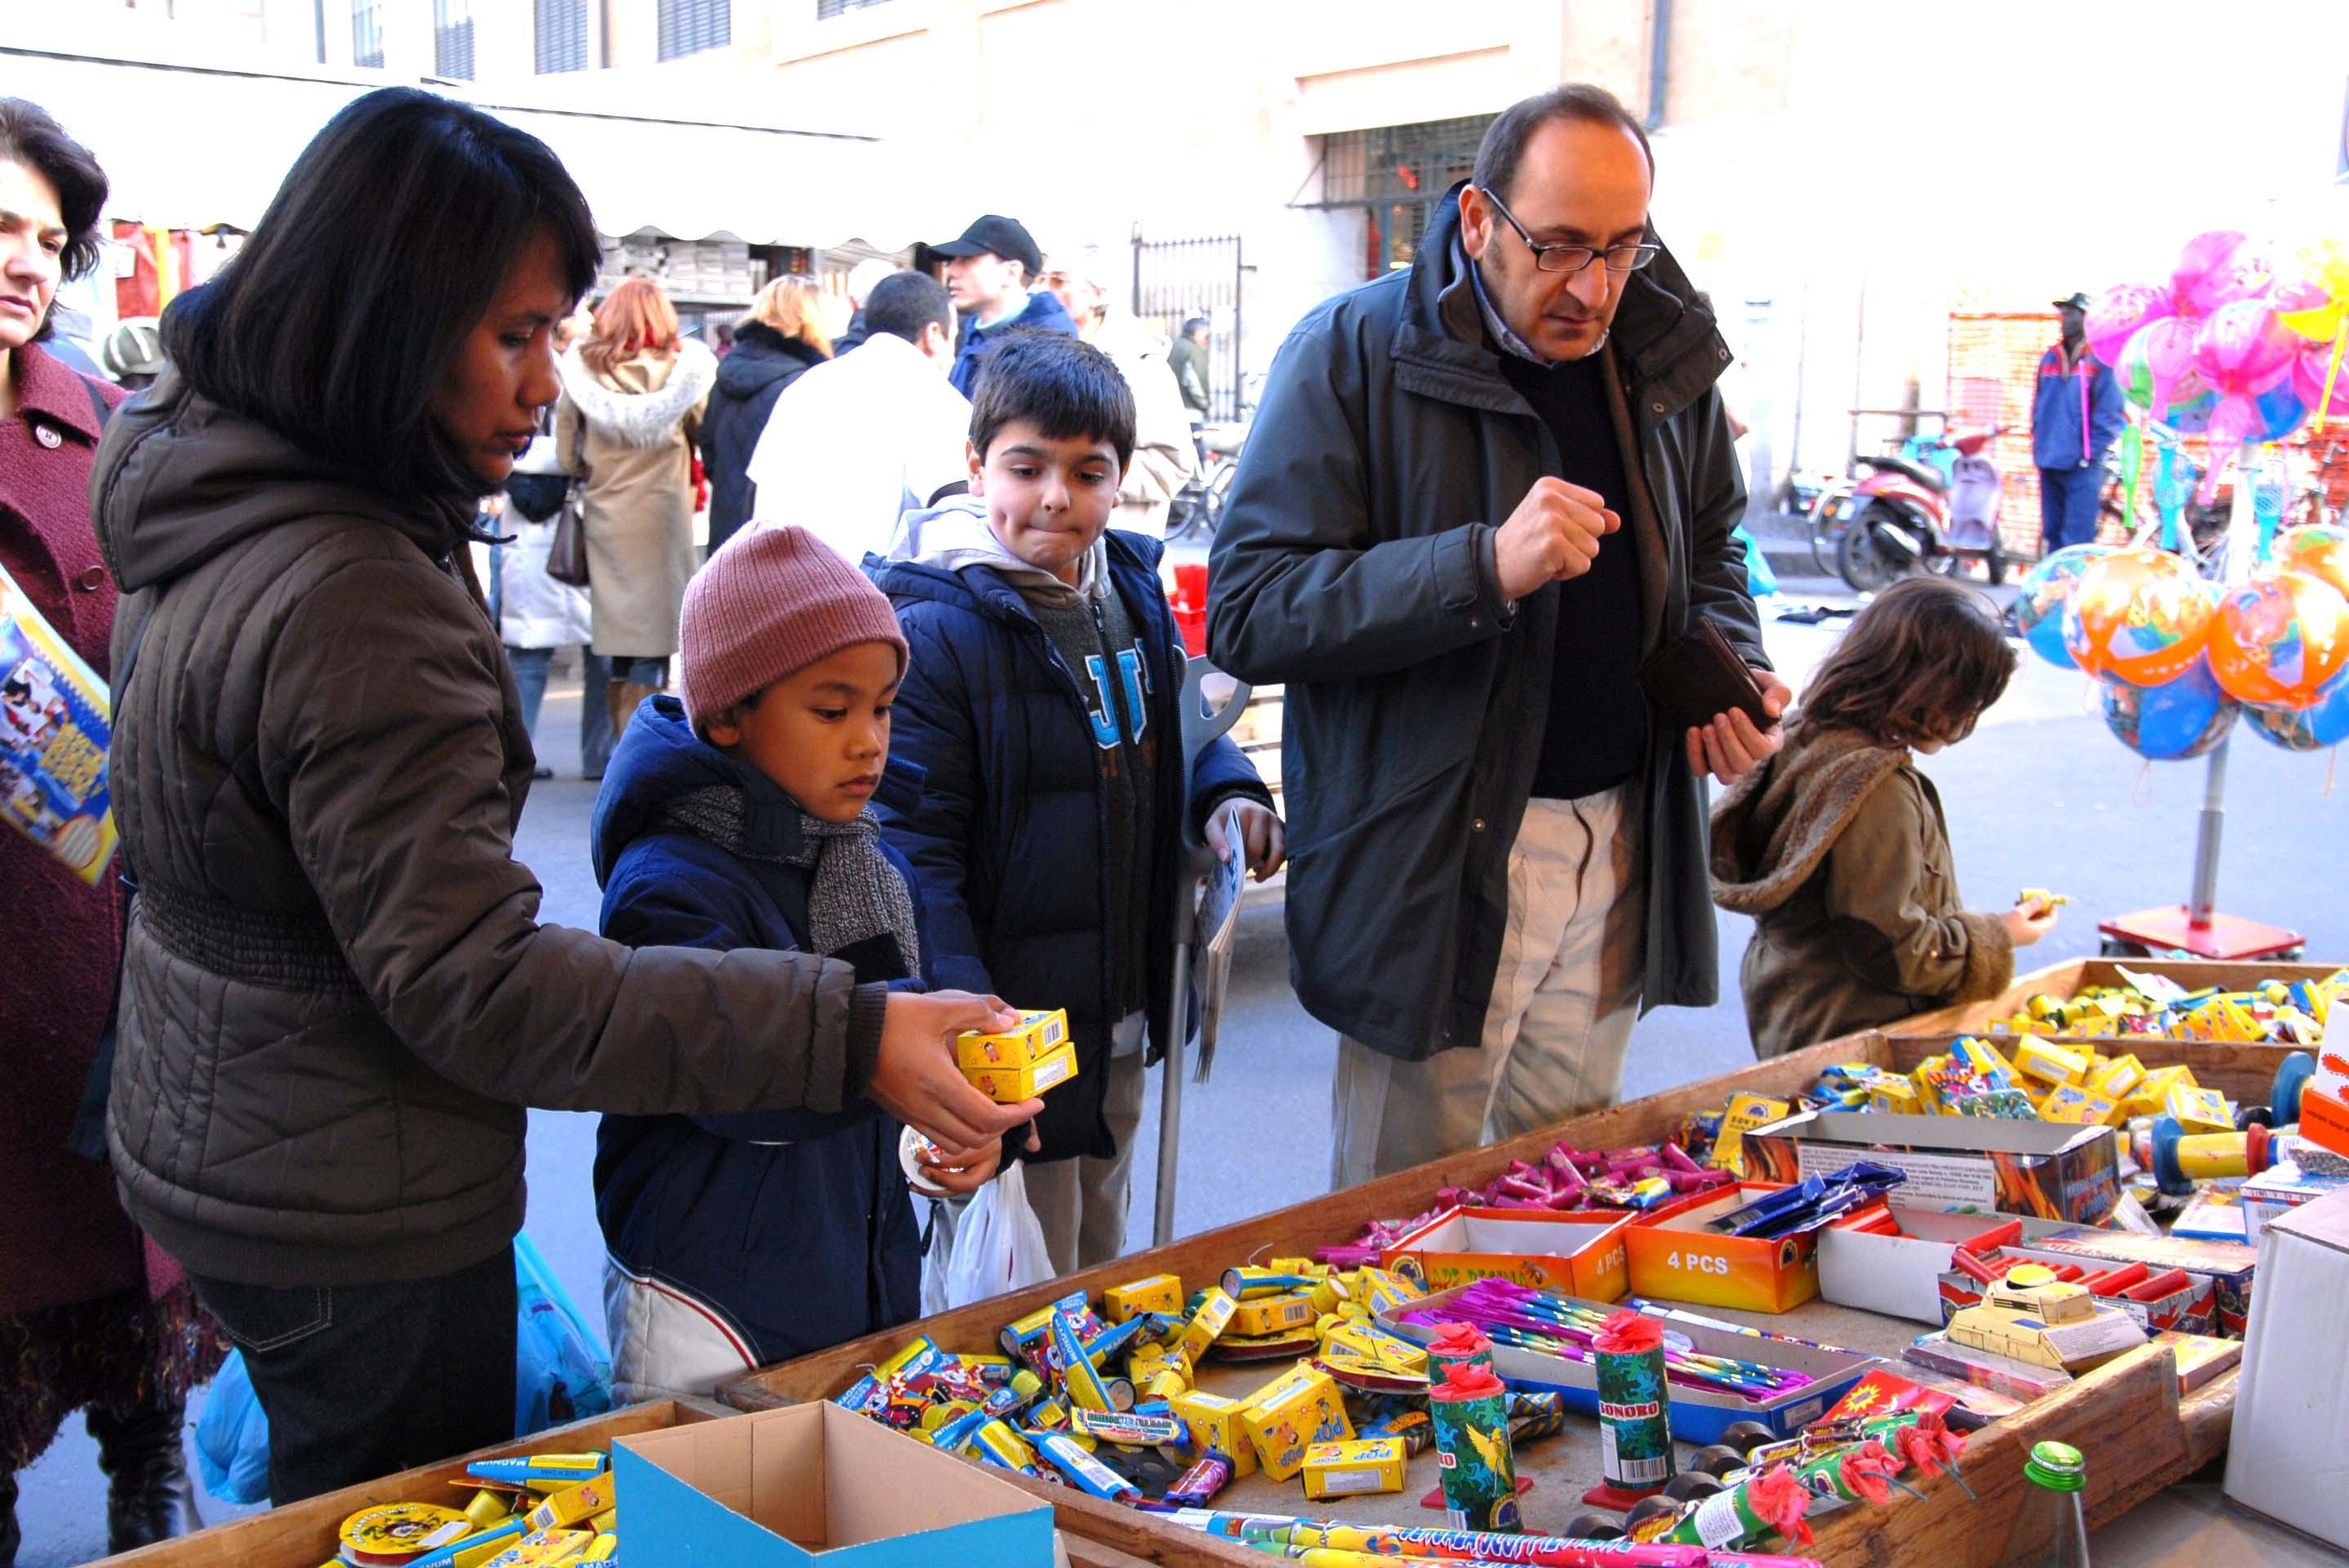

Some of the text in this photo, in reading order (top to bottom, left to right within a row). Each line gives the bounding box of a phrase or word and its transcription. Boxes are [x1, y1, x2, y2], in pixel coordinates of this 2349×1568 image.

[1667, 1251, 1728, 1275] 4 PCS
[1280, 1444, 1304, 1468] POP
[1353, 1450, 1393, 1462] POP
